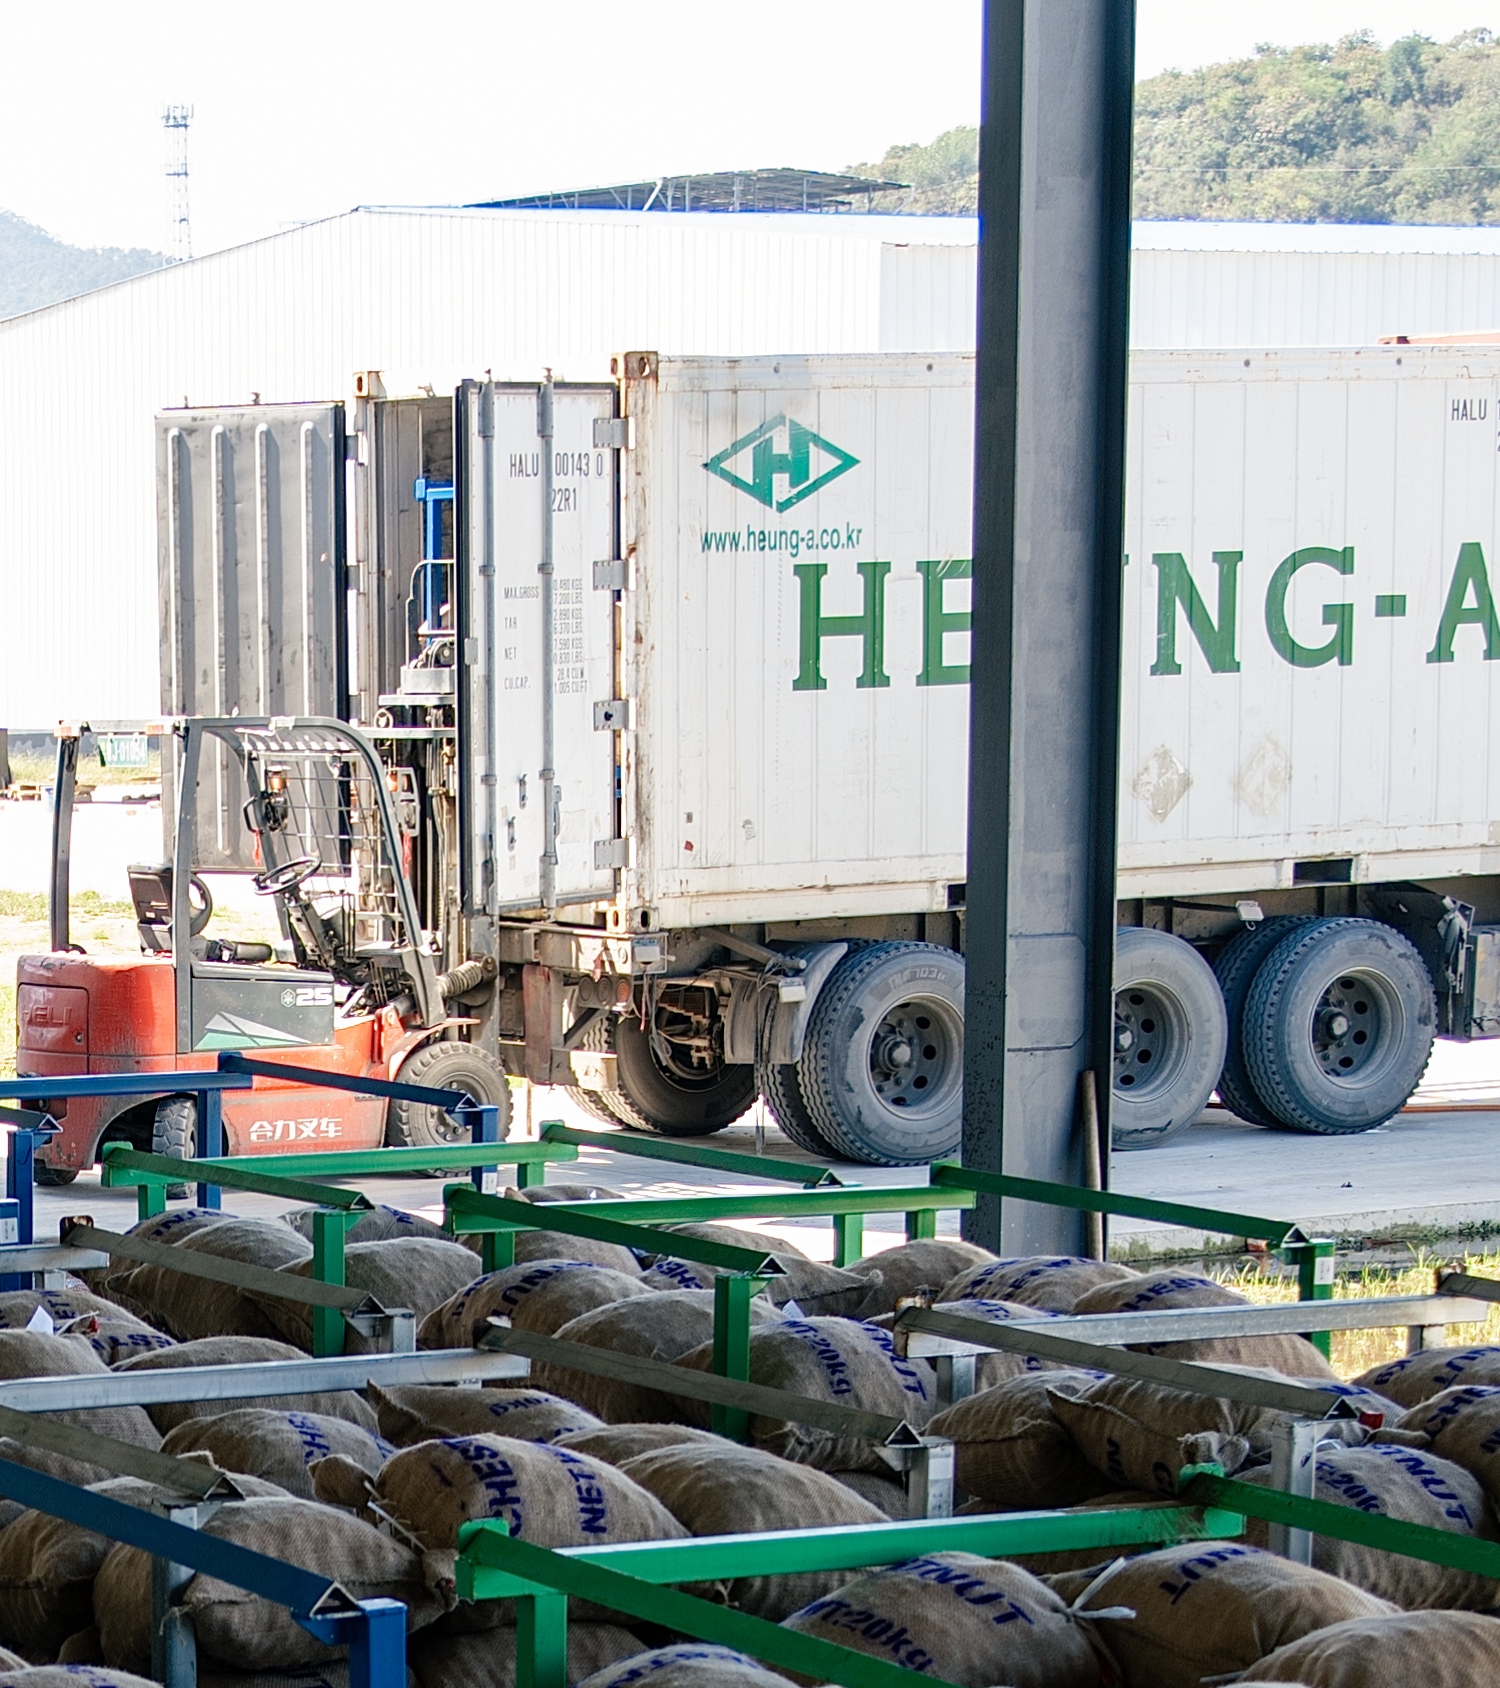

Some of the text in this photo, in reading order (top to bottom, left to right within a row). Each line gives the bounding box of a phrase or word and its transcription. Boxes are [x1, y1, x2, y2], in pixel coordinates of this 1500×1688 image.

[1451, 398, 1488, 421] HALU
[509, 452, 539, 477] HALU
[554, 452, 590, 477] 00143
[700, 522, 863, 558] www.heung-a.co.kr
[504, 647, 518, 660] NET
[296, 987, 333, 1006] 25
[249, 1117, 343, 1142] 合力叉车
